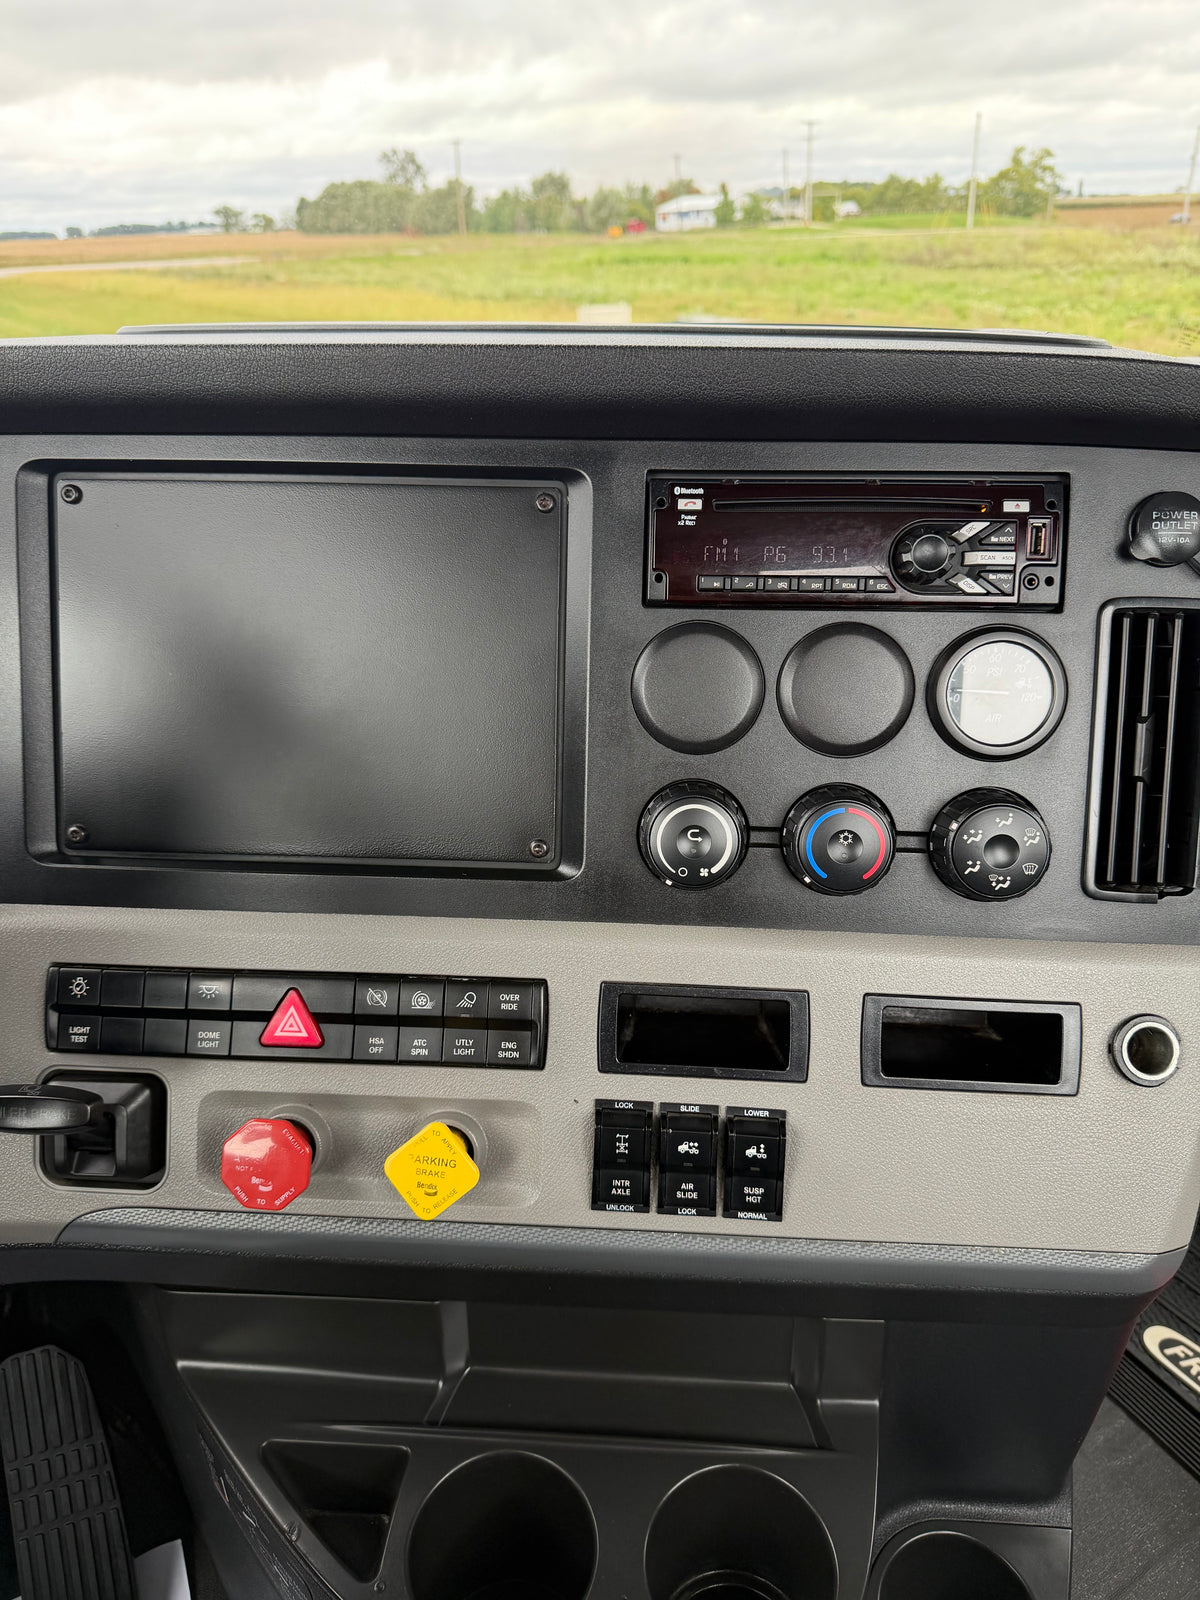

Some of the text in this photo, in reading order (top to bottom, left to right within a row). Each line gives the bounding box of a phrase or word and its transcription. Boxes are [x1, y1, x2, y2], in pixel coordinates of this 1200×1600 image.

[680, 487, 704, 495] Bluetooth
[1152, 511, 1198, 520] POWER
[1152, 521, 1198, 530] OUTLET
[764, 546, 786, 562] P6
[813, 546, 848, 562] 93.1
[500, 994, 520, 1002] OVER
[501, 1003, 518, 1011] RIDE
[69, 1026, 90, 1035] LIGHT
[198, 1031, 220, 1039] DOME
[198, 1040, 219, 1048] LIGHT
[369, 1037, 384, 1045] HSA
[413, 1039, 427, 1047] ATC
[455, 1039, 474, 1047] UTLY
[369, 1046, 383, 1054] OFF
[501, 1042, 517, 1050] ENG
[411, 1048, 428, 1056] SPIN
[453, 1048, 475, 1056] LIGHT
[498, 1050, 520, 1059] SHDN
[744, 1109, 769, 1117] LOWER
[432, 1129, 441, 1137] TO
[441, 1138, 457, 1155] APPLY
[415, 1167, 446, 1179] BRAKE
[416, 1181, 438, 1190] Bendix
[681, 1182, 694, 1190] AIR
[611, 1188, 631, 1196] AXLE
[676, 1191, 698, 1199] SLIDE
[744, 1187, 764, 1195] SUSP
[234, 1185, 296, 1206] PUSH TO SUPPLY
[406, 1190, 420, 1208] PUSH
[432, 1188, 458, 1210] RELEASE
[746, 1196, 762, 1204] HGT
[606, 1204, 634, 1212] UNLOCK
[738, 1212, 767, 1220] NORMAL
[1163, 1345, 1200, 1381] FR
